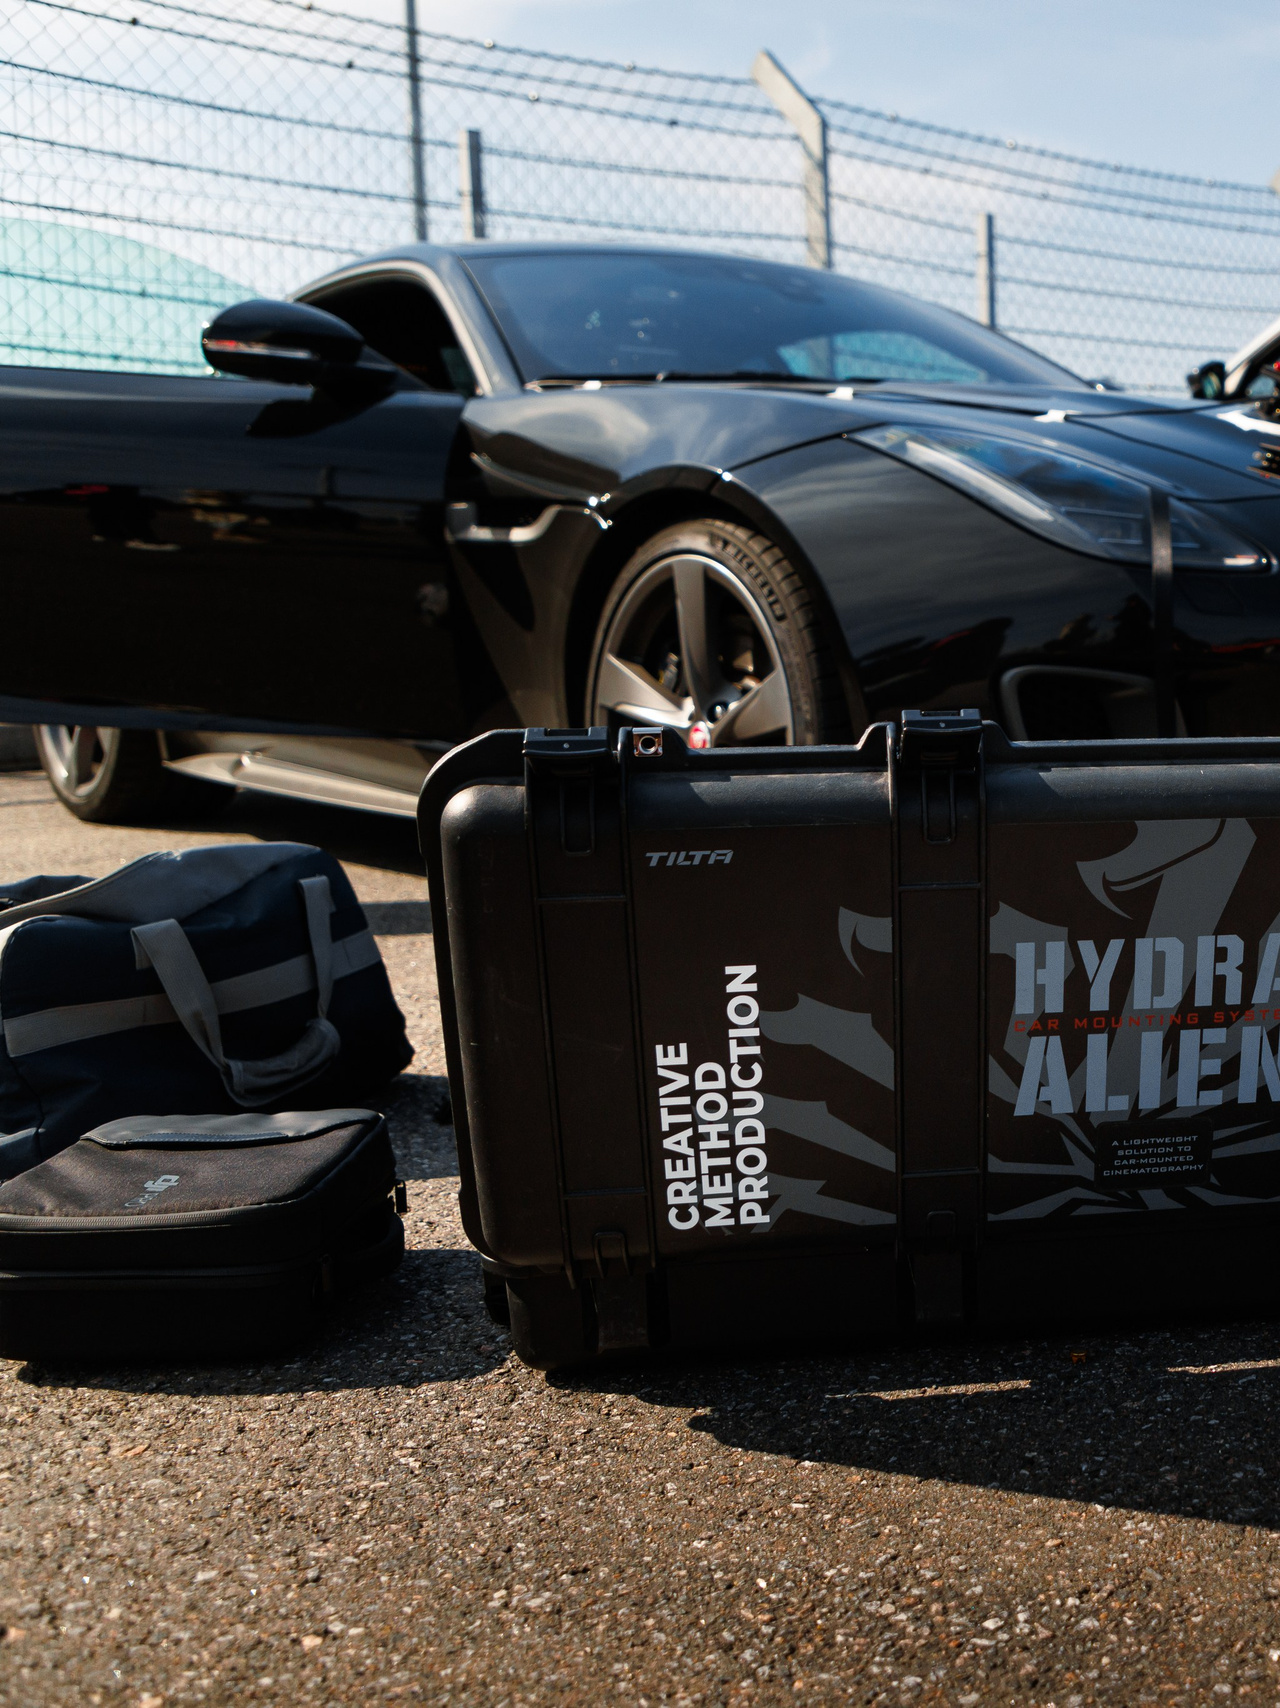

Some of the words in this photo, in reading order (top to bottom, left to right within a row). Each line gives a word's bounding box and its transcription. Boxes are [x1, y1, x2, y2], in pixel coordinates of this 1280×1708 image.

[645, 849, 734, 867] TILTA
[1014, 1018, 1060, 1033] CAR
[1074, 1012, 1200, 1030] MOUNTING
[724, 964, 770, 1225] PRODUCTION
[655, 1042, 700, 1231] CREATIVE
[694, 1062, 735, 1227] METHOD
[1123, 1135, 1198, 1146] LIGHTWEIGHT
[1114, 1155, 1194, 1166] CAR-MOUNTED
[1117, 1147, 1174, 1156] SOLUTION
[1103, 1164, 1204, 1176] CINEMATOGRAPHY
